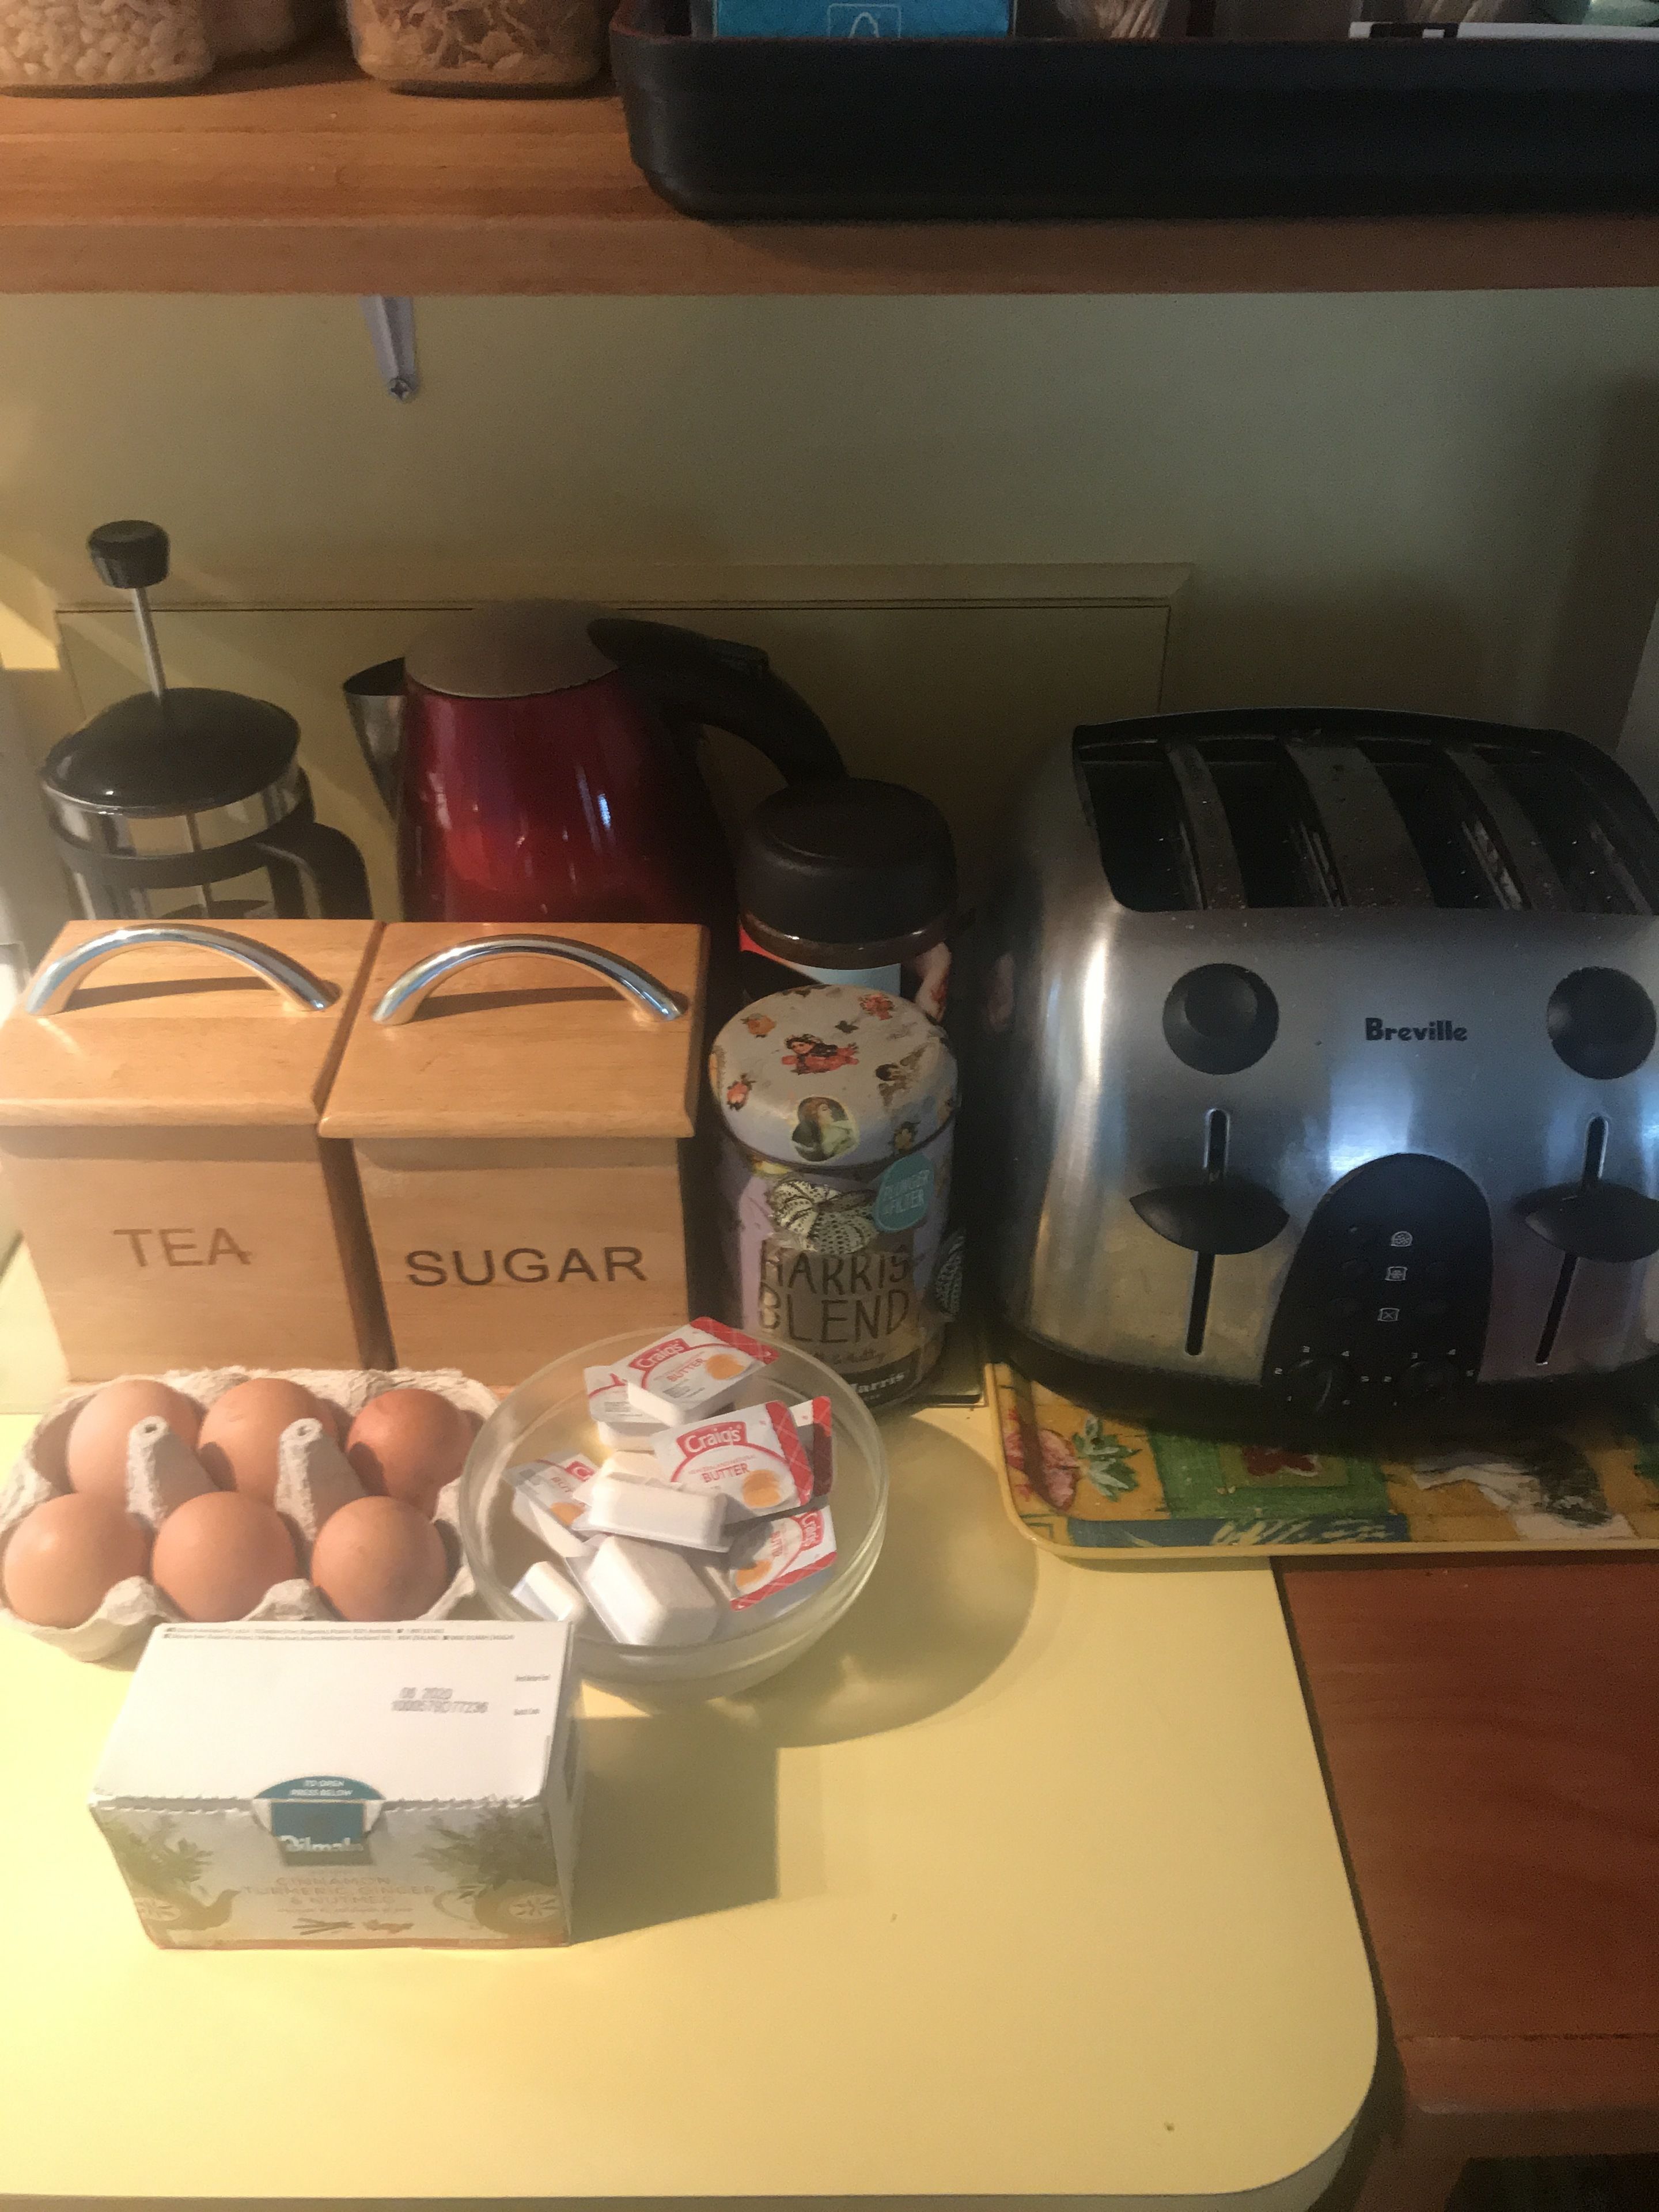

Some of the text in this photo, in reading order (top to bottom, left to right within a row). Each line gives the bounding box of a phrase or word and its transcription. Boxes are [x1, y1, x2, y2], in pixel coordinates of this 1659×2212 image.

[1365, 1017, 1468, 1041] Breville
[113, 1228, 251, 1267] TEA
[405, 1247, 647, 1286] SUGAR
[760, 1240, 910, 1295] HARRIS
[759, 1282, 910, 1343] BLEND
[666, 1358, 706, 1382] BUTTER
[701, 1463, 749, 1483] BUTTER
